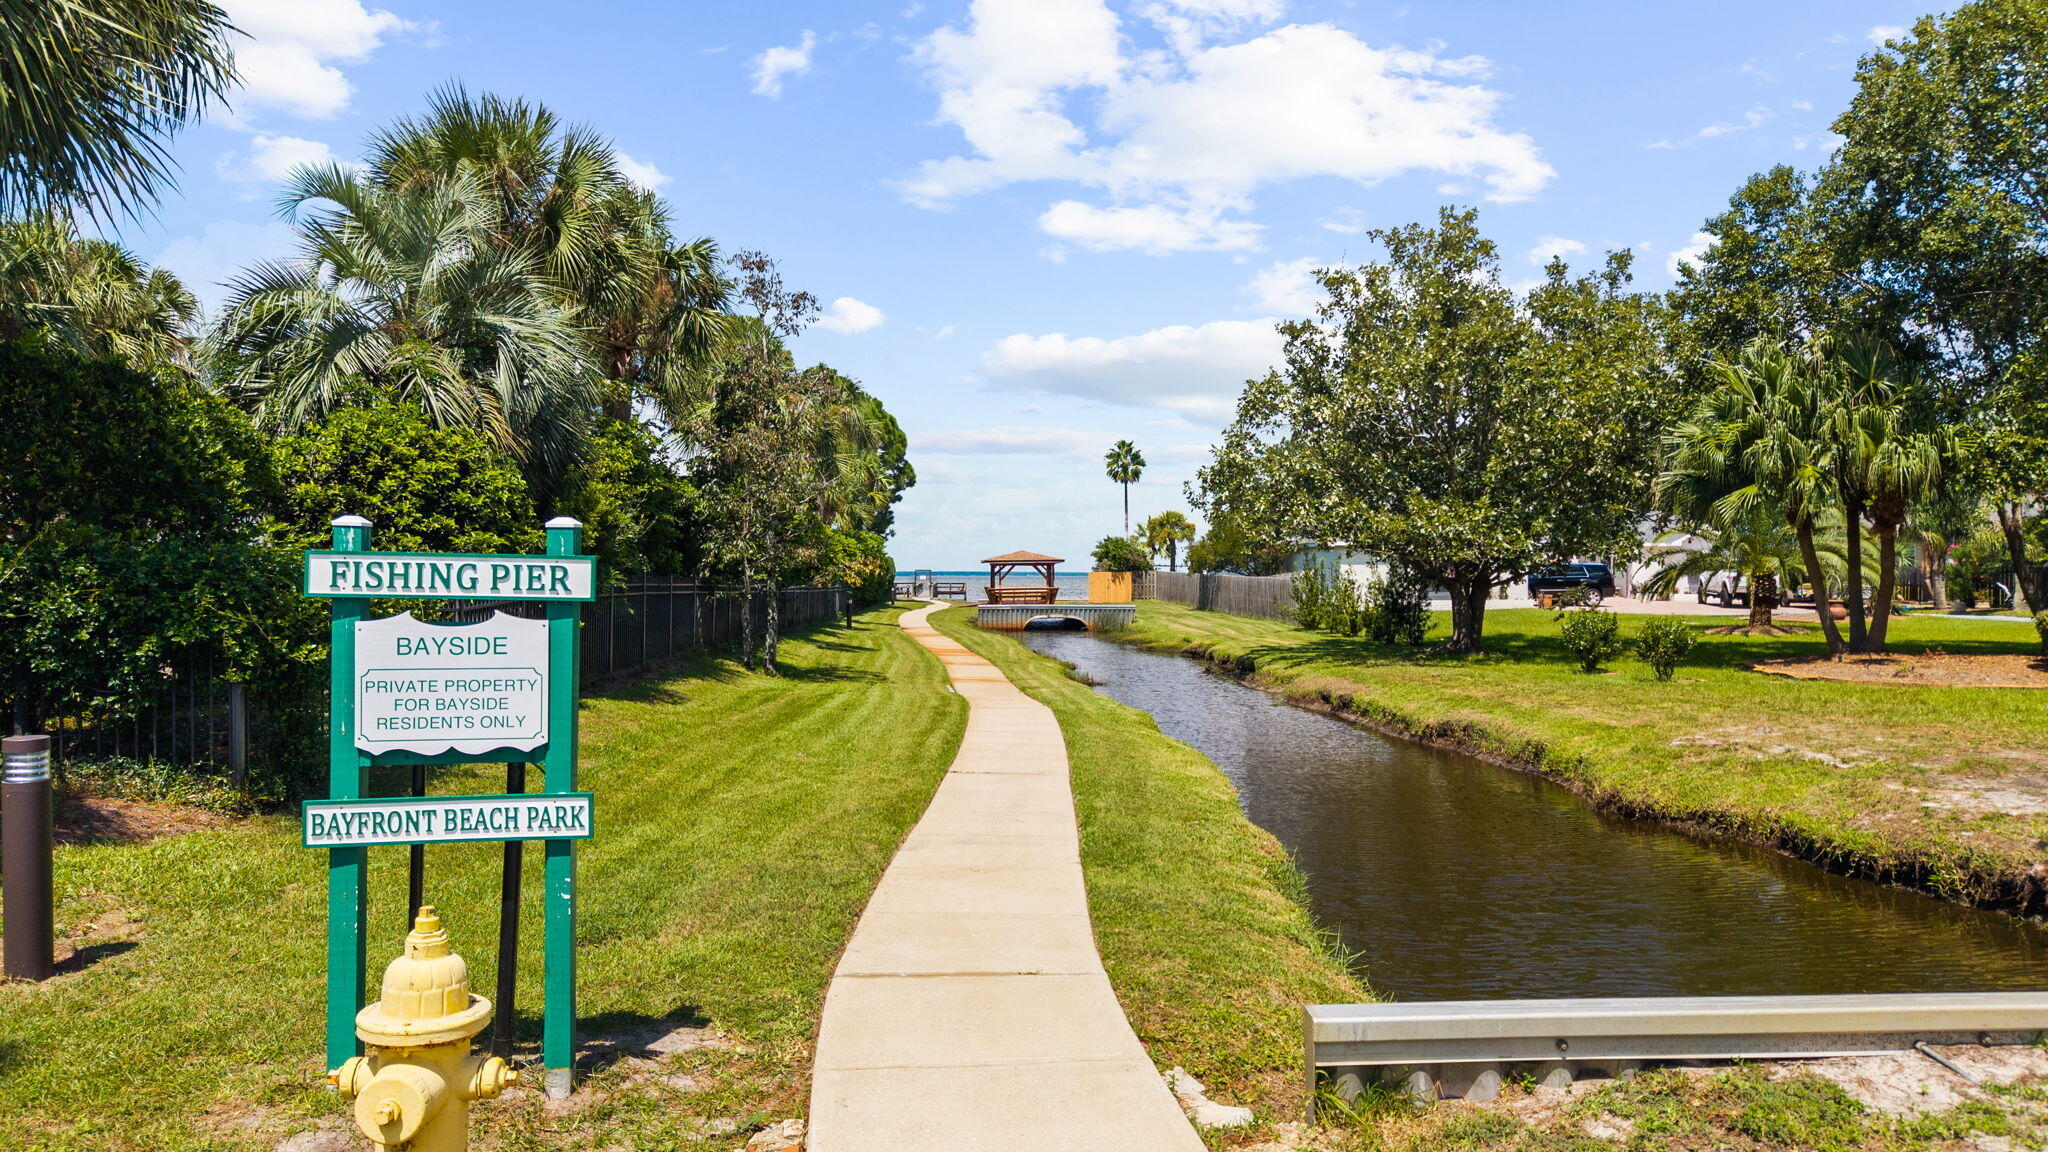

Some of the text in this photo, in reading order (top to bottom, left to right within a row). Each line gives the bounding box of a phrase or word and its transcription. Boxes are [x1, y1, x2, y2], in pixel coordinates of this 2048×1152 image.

[330, 561, 571, 591] FISHING PIER
[396, 637, 508, 656] BAYSIDE
[365, 679, 538, 693] PRIVATE PROPERTY
[394, 698, 509, 711] FOR BAYSIDE
[377, 716, 526, 730] RESIDENTS ONLY
[311, 805, 585, 837] BAYFRONT BEACH PARK
